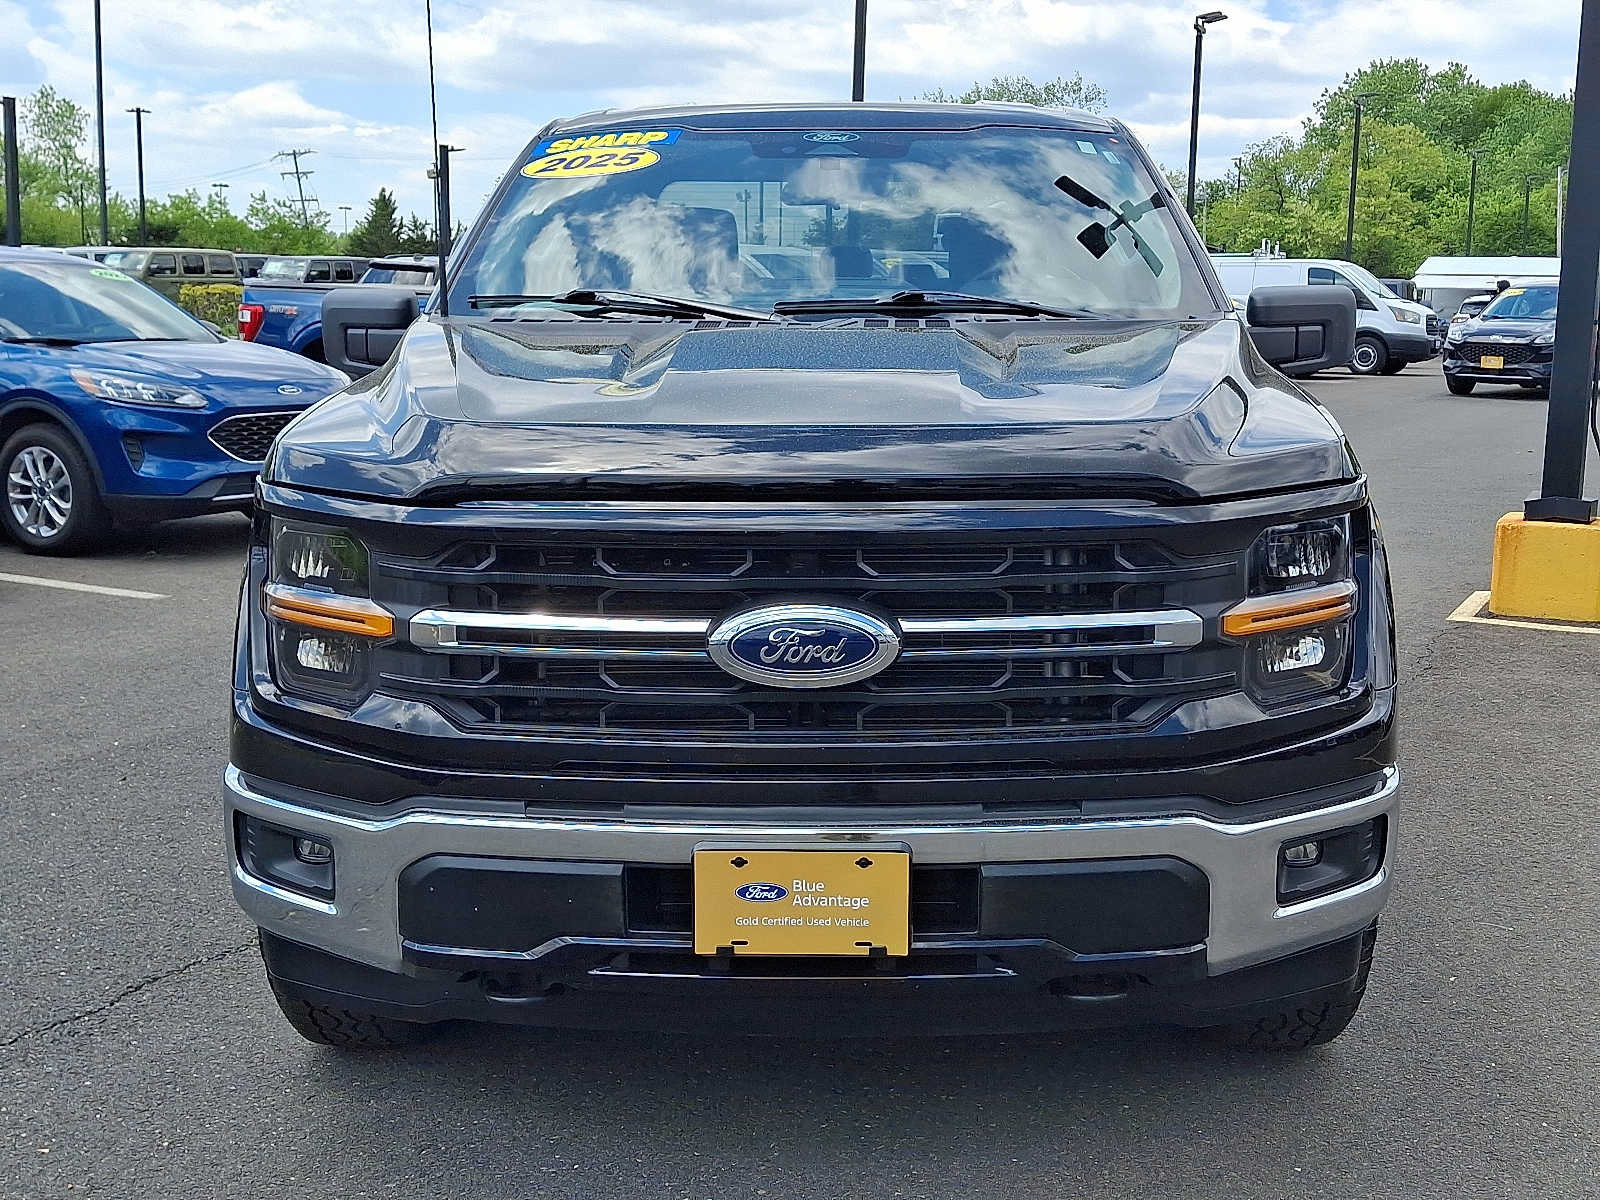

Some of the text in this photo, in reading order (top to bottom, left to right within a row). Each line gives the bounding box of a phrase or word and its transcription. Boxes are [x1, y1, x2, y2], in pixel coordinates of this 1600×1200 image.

[545, 131, 668, 153] SHARP
[533, 151, 647, 174] 2025
[760, 627, 848, 663] Ford
[745, 885, 778, 900] Ford
[792, 879, 825, 892] Blue
[792, 894, 870, 909] Advantage
[735, 916, 870, 927] Gold Certified Used Vehicle
